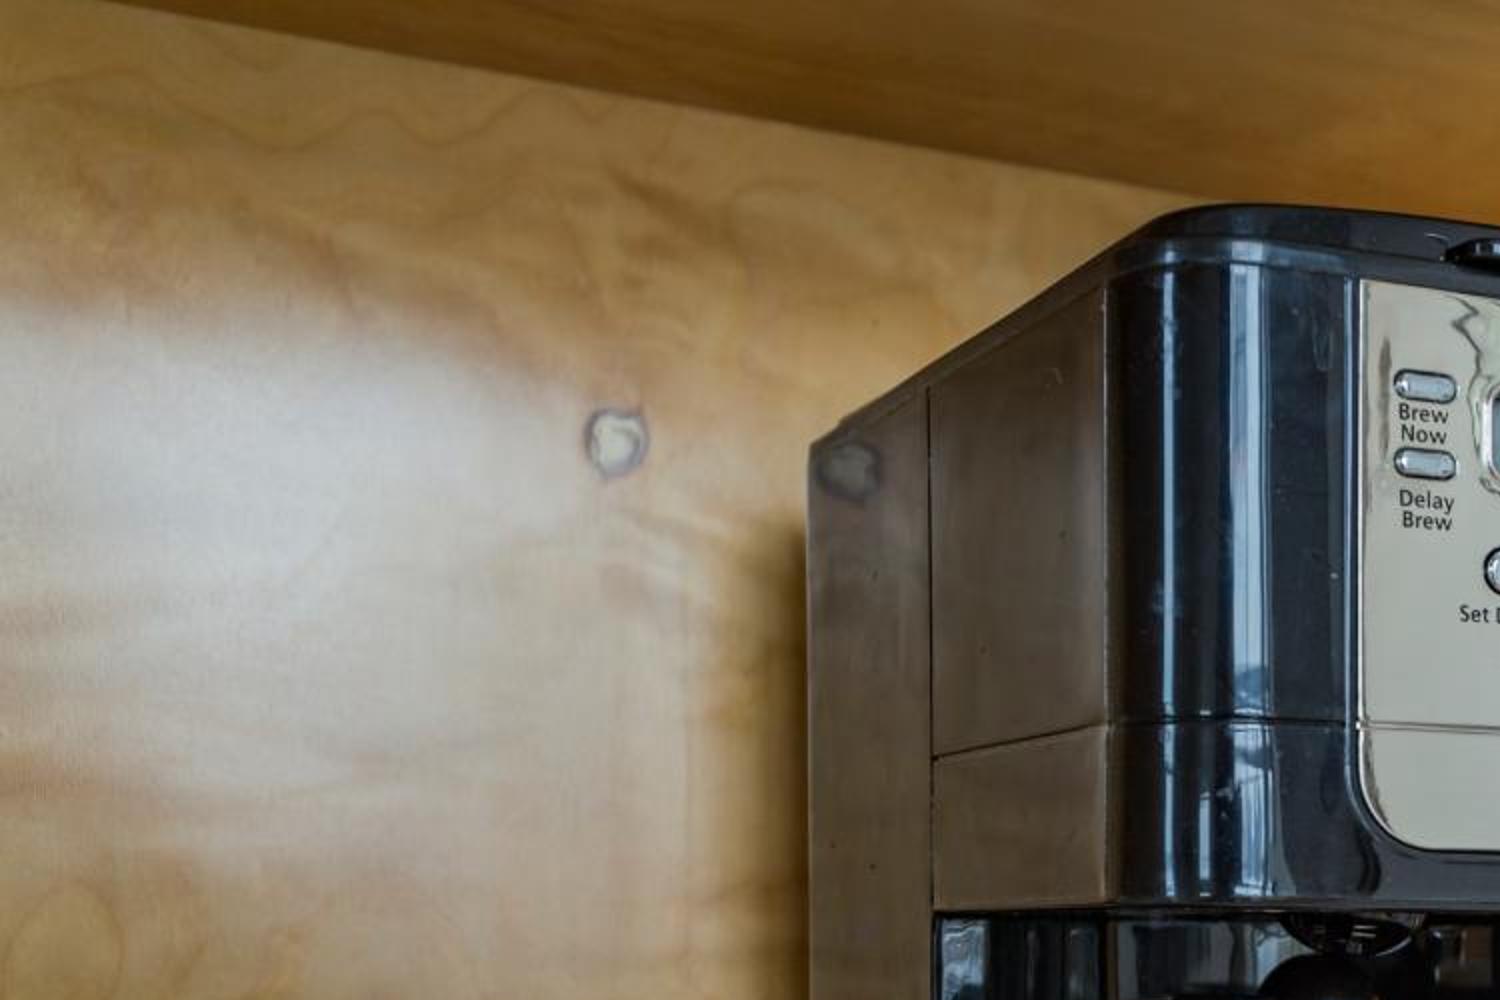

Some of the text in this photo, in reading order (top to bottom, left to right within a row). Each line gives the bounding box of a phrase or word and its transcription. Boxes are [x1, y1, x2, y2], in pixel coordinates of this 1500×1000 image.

[1398, 402, 1449, 424] Brew
[1401, 424, 1447, 444] Now
[1399, 489, 1455, 515] Delay
[1402, 510, 1452, 531] Brew
[1459, 605, 1489, 624] Set
